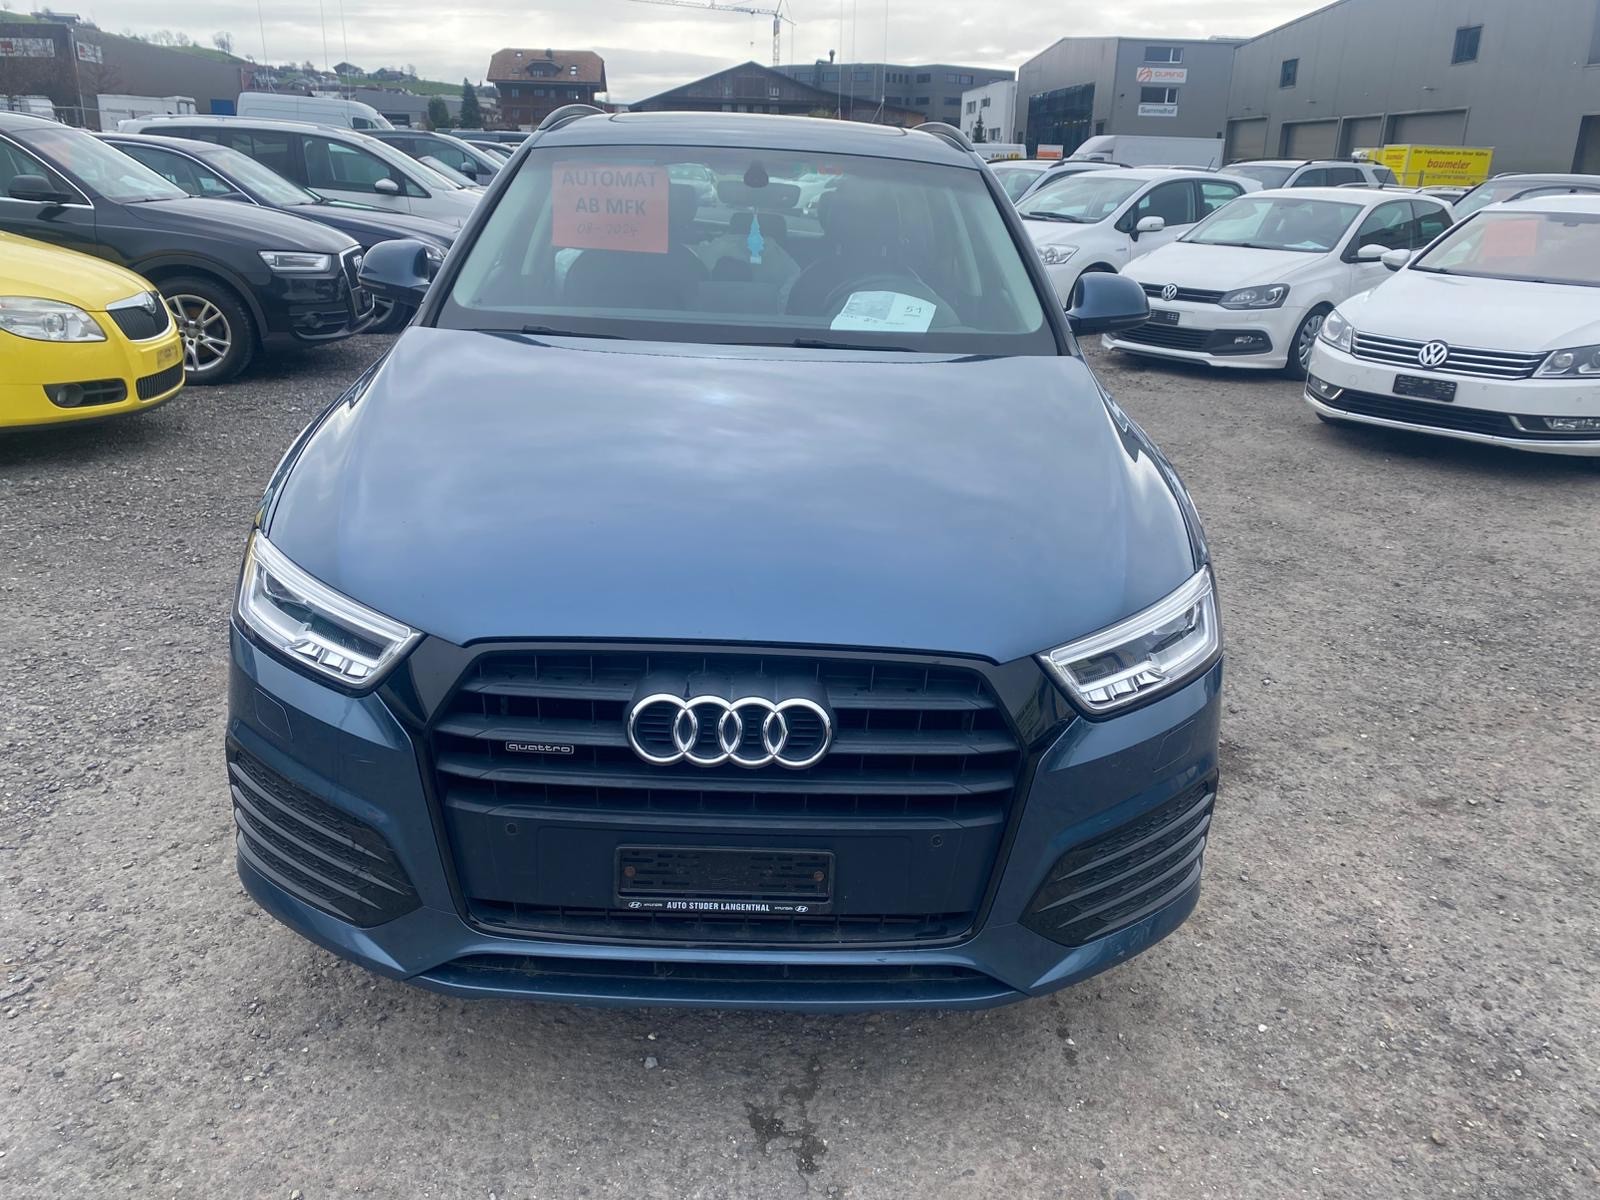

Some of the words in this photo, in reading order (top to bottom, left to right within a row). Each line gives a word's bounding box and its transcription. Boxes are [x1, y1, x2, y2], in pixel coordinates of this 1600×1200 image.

[1427, 159, 1471, 169] baumeler
[562, 170, 657, 187] AUTOMAT
[575, 196, 600, 213] AB
[606, 198, 647, 215] MFK
[508, 743, 571, 753] quattro
[666, 901, 687, 909] AUTO
[688, 902, 719, 910] STUDER
[720, 903, 770, 911] LANGENTHAL
